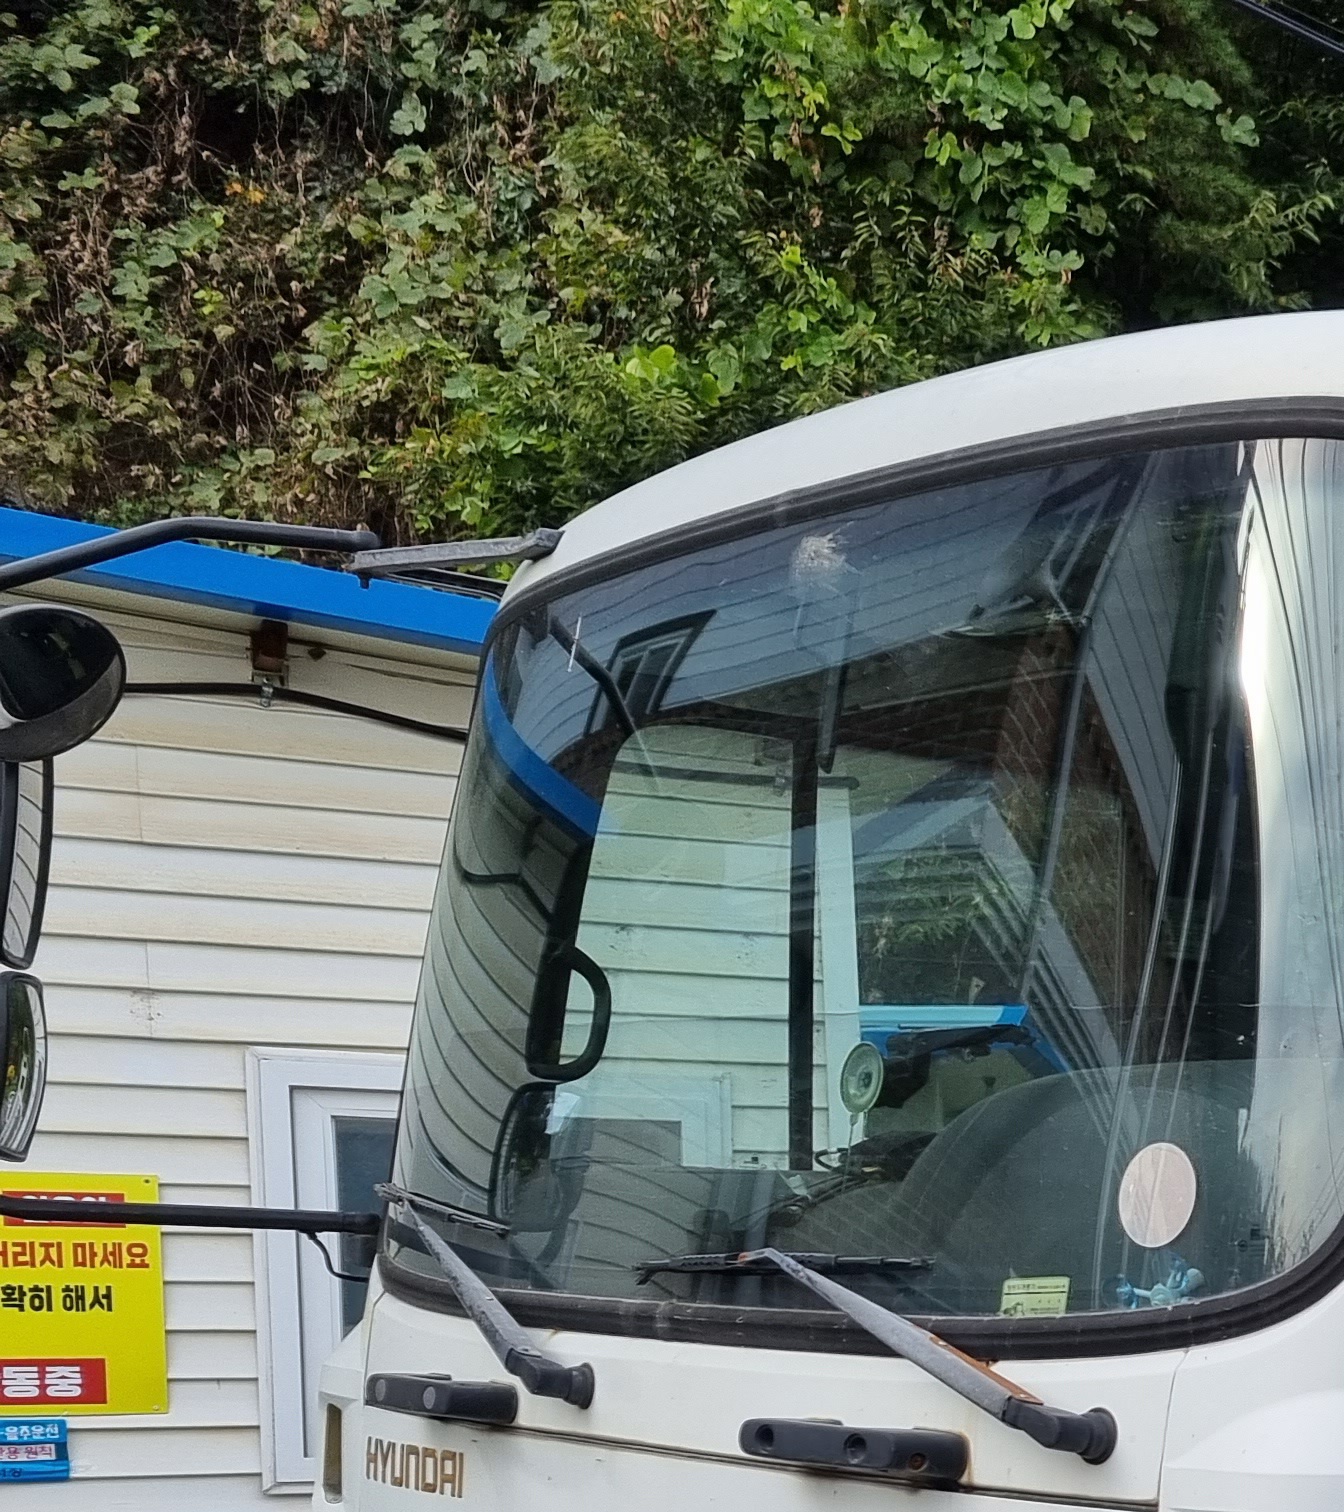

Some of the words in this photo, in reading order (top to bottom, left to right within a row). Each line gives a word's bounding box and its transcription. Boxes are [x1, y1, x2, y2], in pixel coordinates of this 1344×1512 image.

[72, 1241, 150, 1269] 마세요
[1, 1284, 53, 1312] 확히
[61, 1285, 113, 1312] 해서
[0, 1446, 20, 1460] 용
[365, 1436, 464, 1498] HYUNDAI
